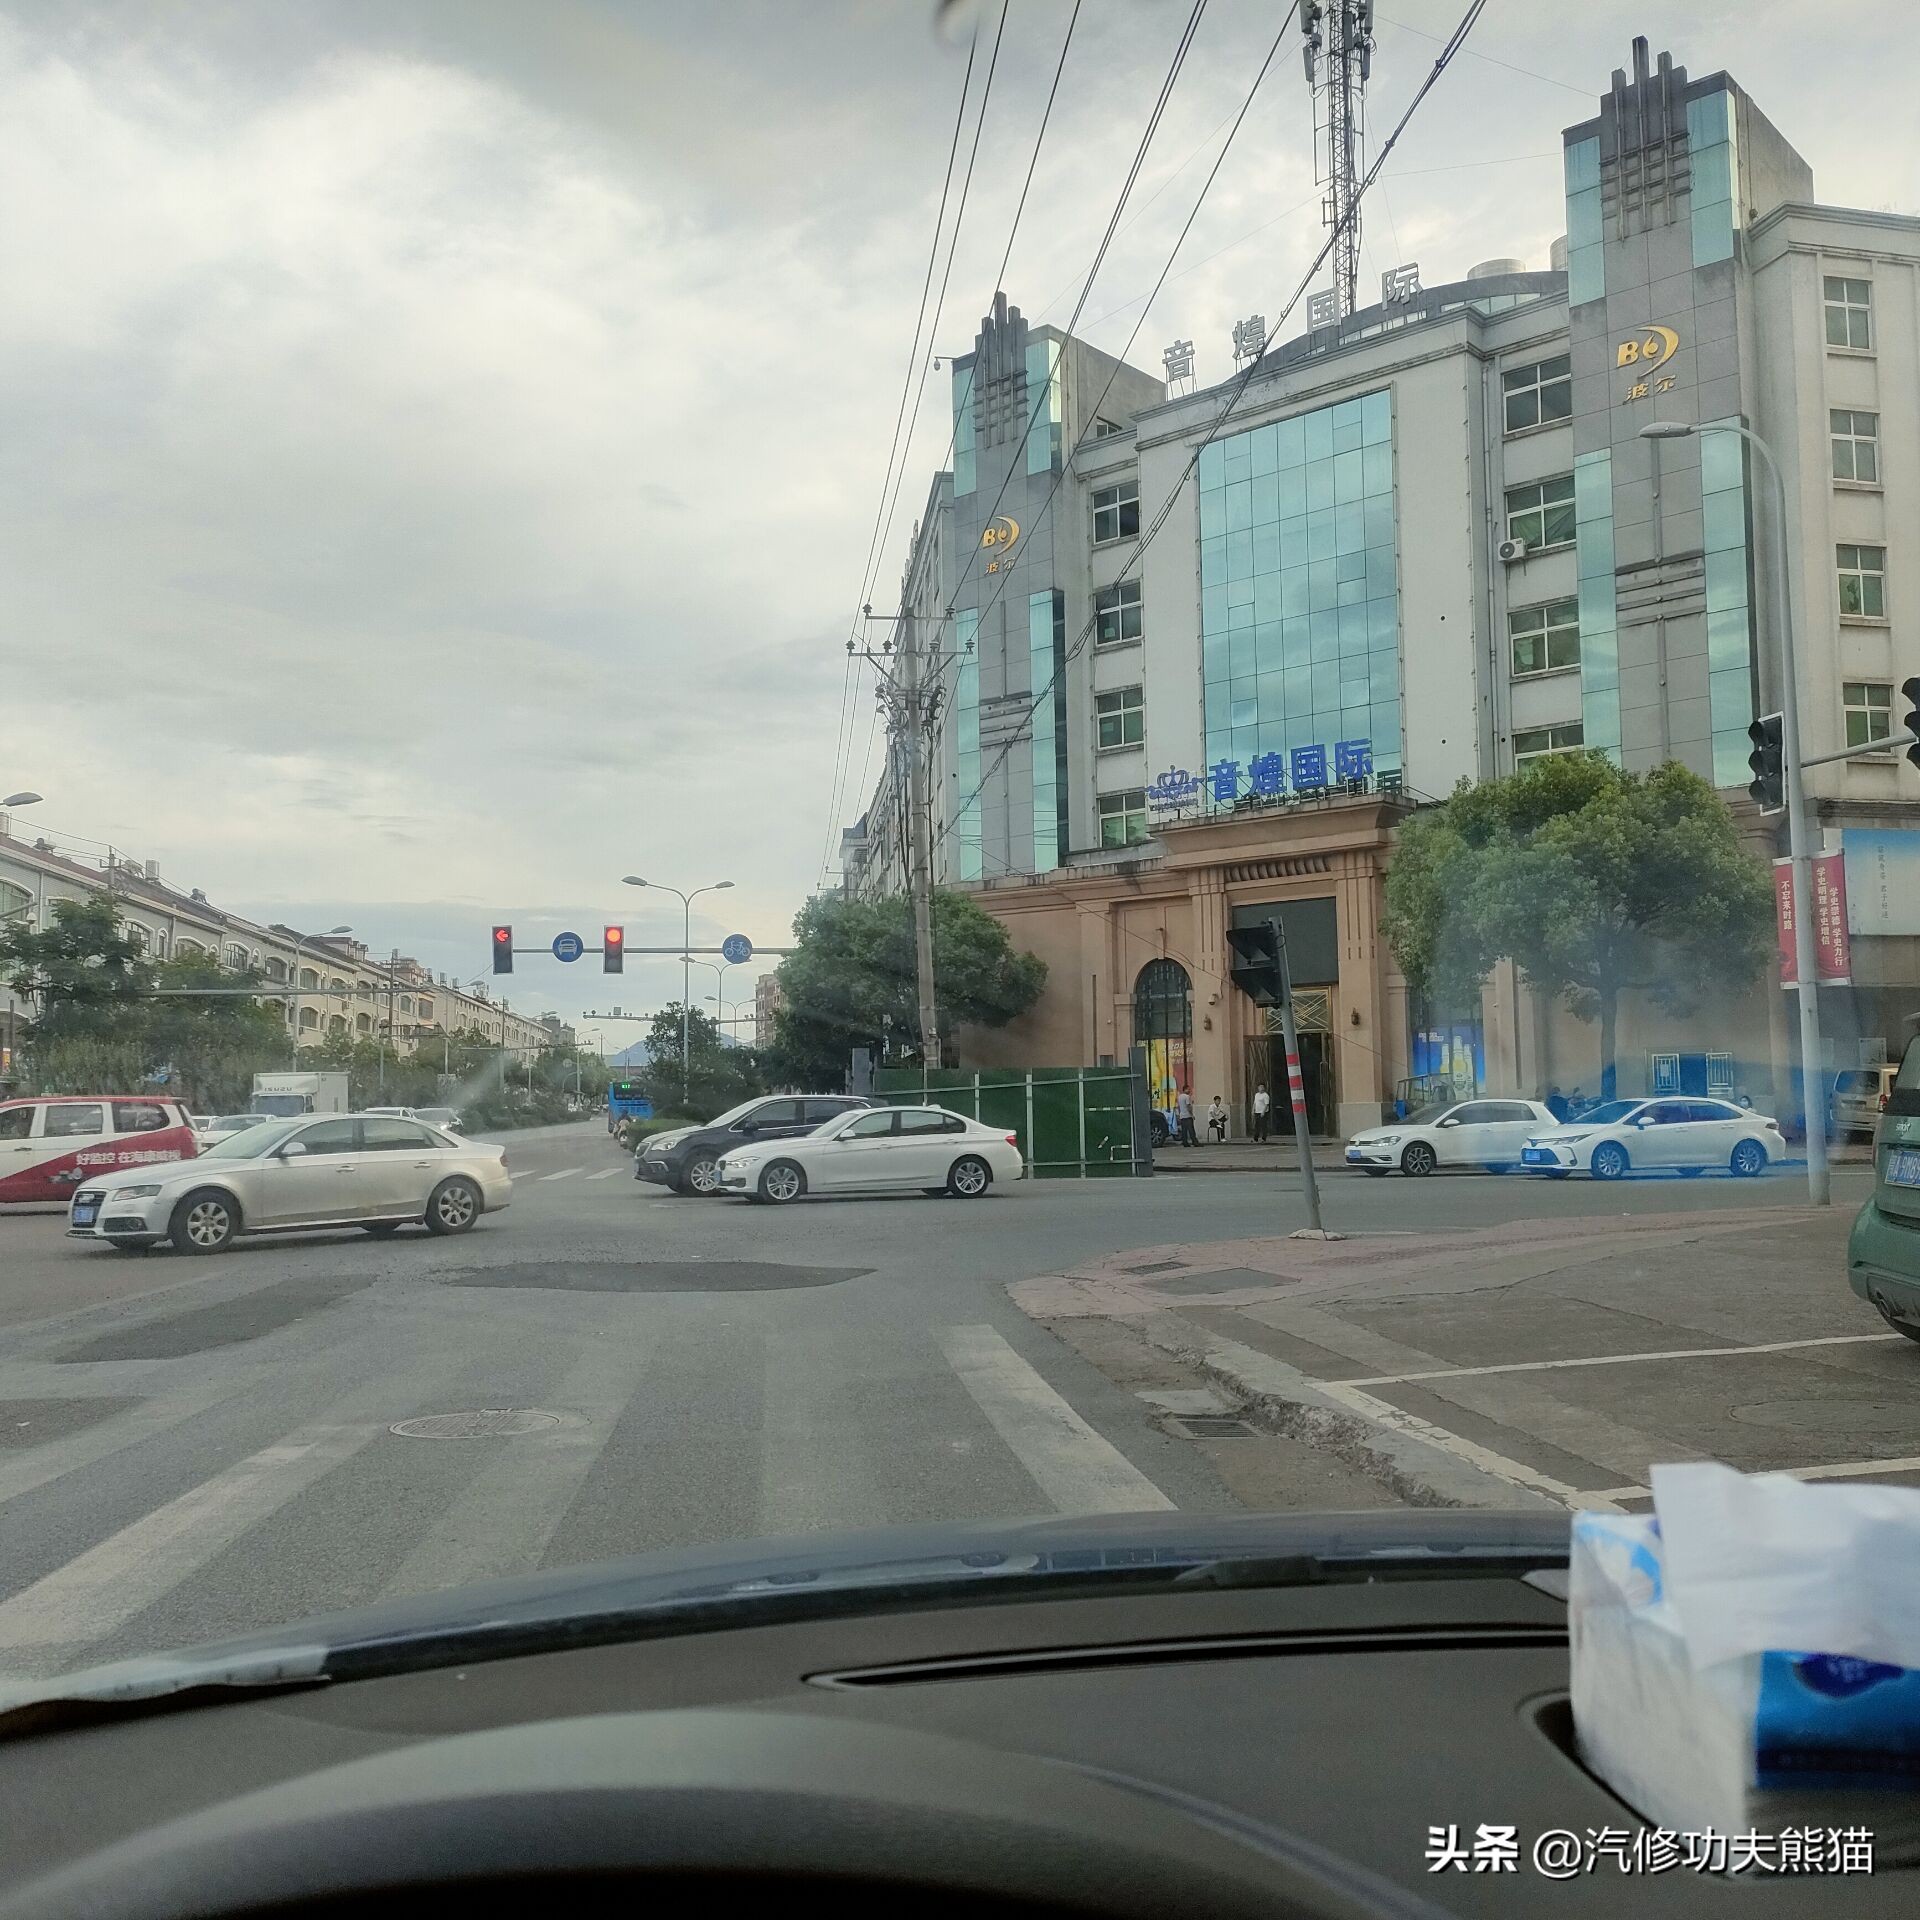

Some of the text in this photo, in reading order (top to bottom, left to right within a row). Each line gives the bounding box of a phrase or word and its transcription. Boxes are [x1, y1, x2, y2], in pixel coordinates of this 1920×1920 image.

[1162, 262, 1423, 381] 音煌国际
[1622, 374, 1677, 405] 波尔
[1208, 738, 1374, 801] 音煌国际
[1780, 880, 1792, 930] 不忘来时路
[1816, 866, 1830, 945] 学史明理 学史增信
[1829, 887, 1843, 967] 学史崇德 学史力行
